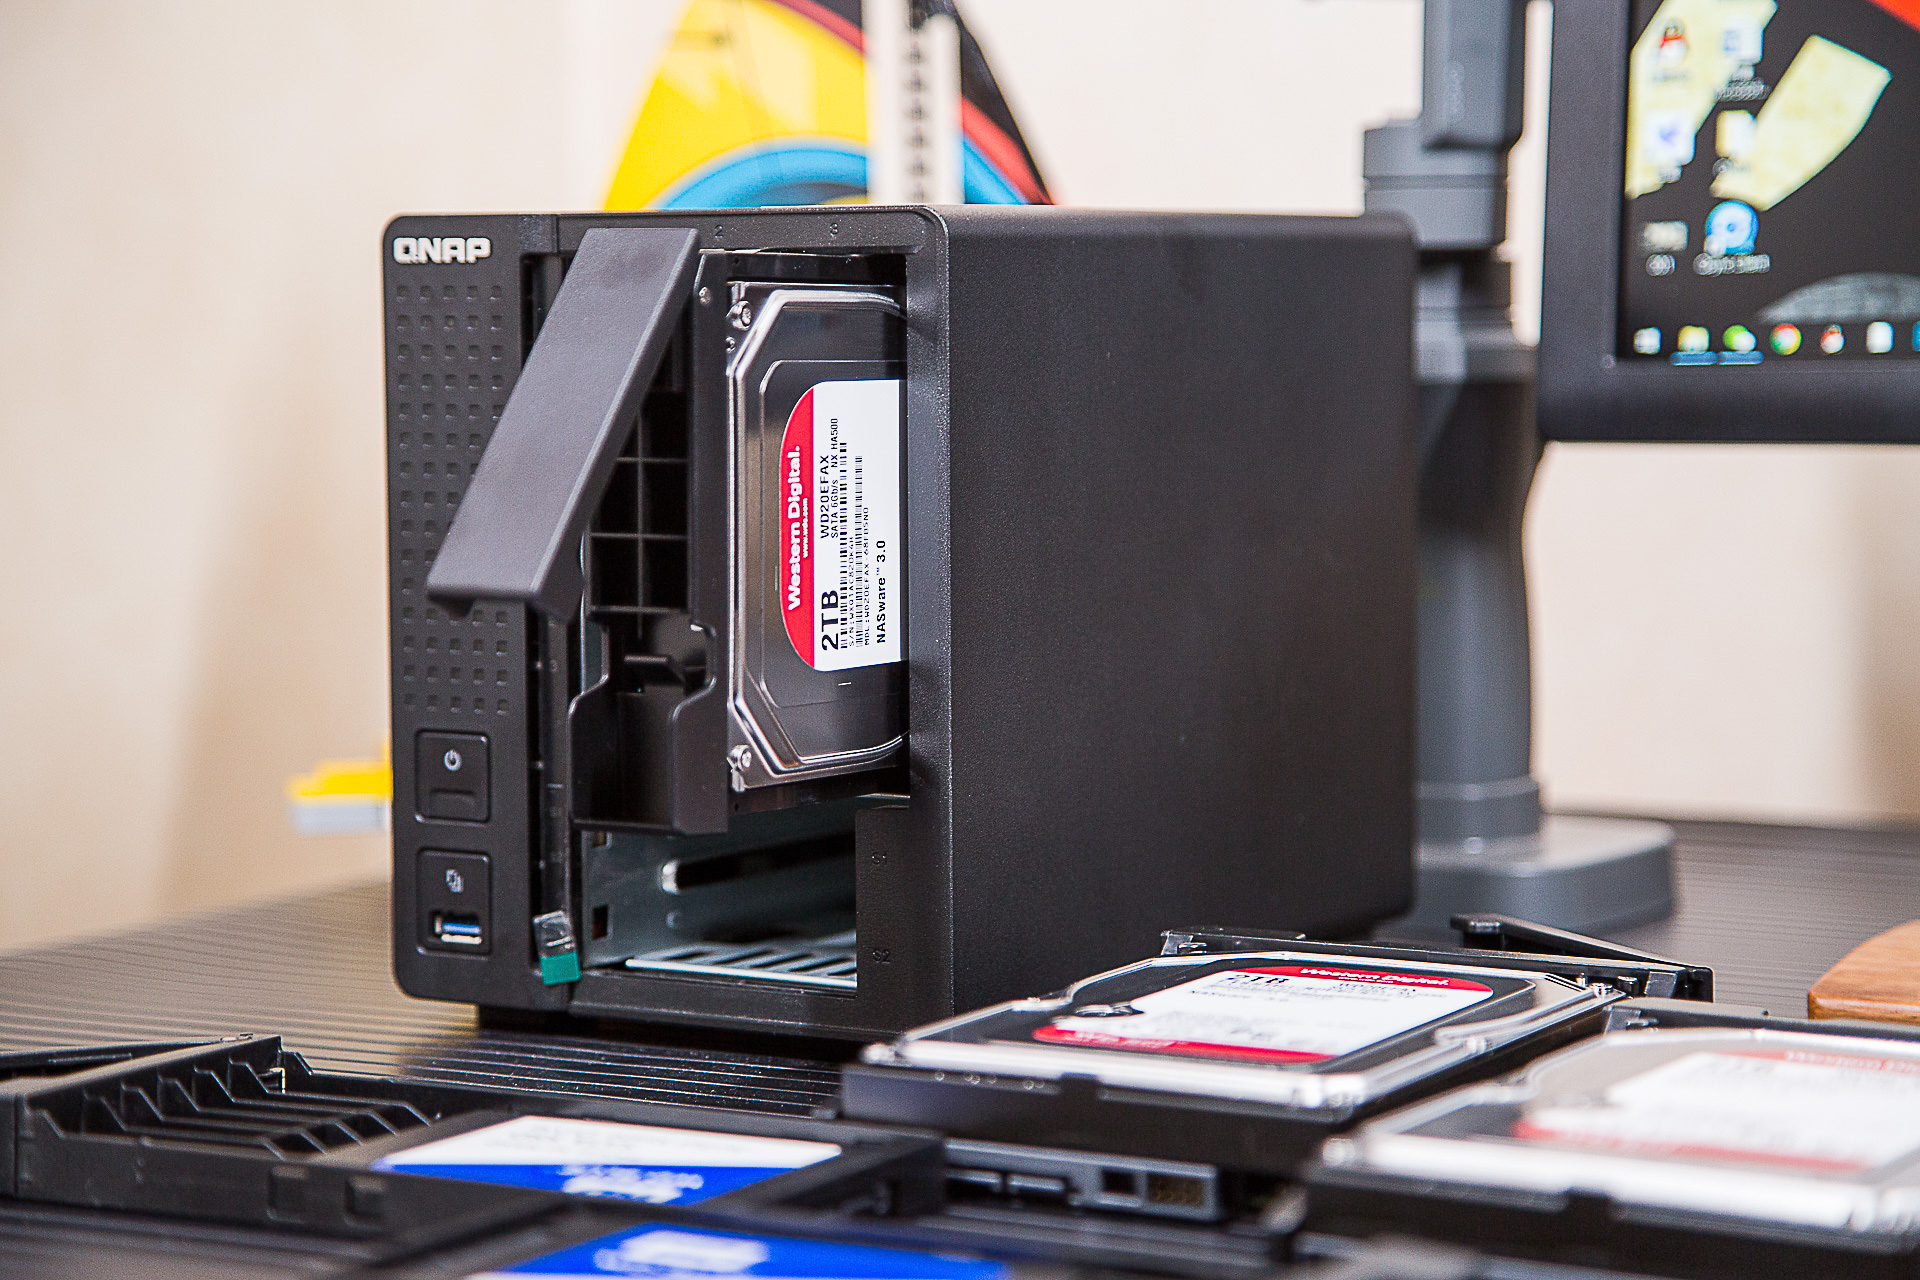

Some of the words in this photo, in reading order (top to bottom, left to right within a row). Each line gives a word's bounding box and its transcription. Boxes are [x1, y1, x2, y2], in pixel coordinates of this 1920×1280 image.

[393, 237, 491, 264] QNAP
[830, 418, 839, 450] HA500
[830, 453, 839, 468] NX
[820, 454, 830, 539] WD20EFAX
[830, 479, 839, 508] 6Gb/s
[801, 497, 809, 559] www.wdc.com
[830, 511, 839, 539] SATA
[787, 521, 802, 610] Western
[875, 540, 887, 563] 3.0
[820, 590, 839, 651] 2TB
